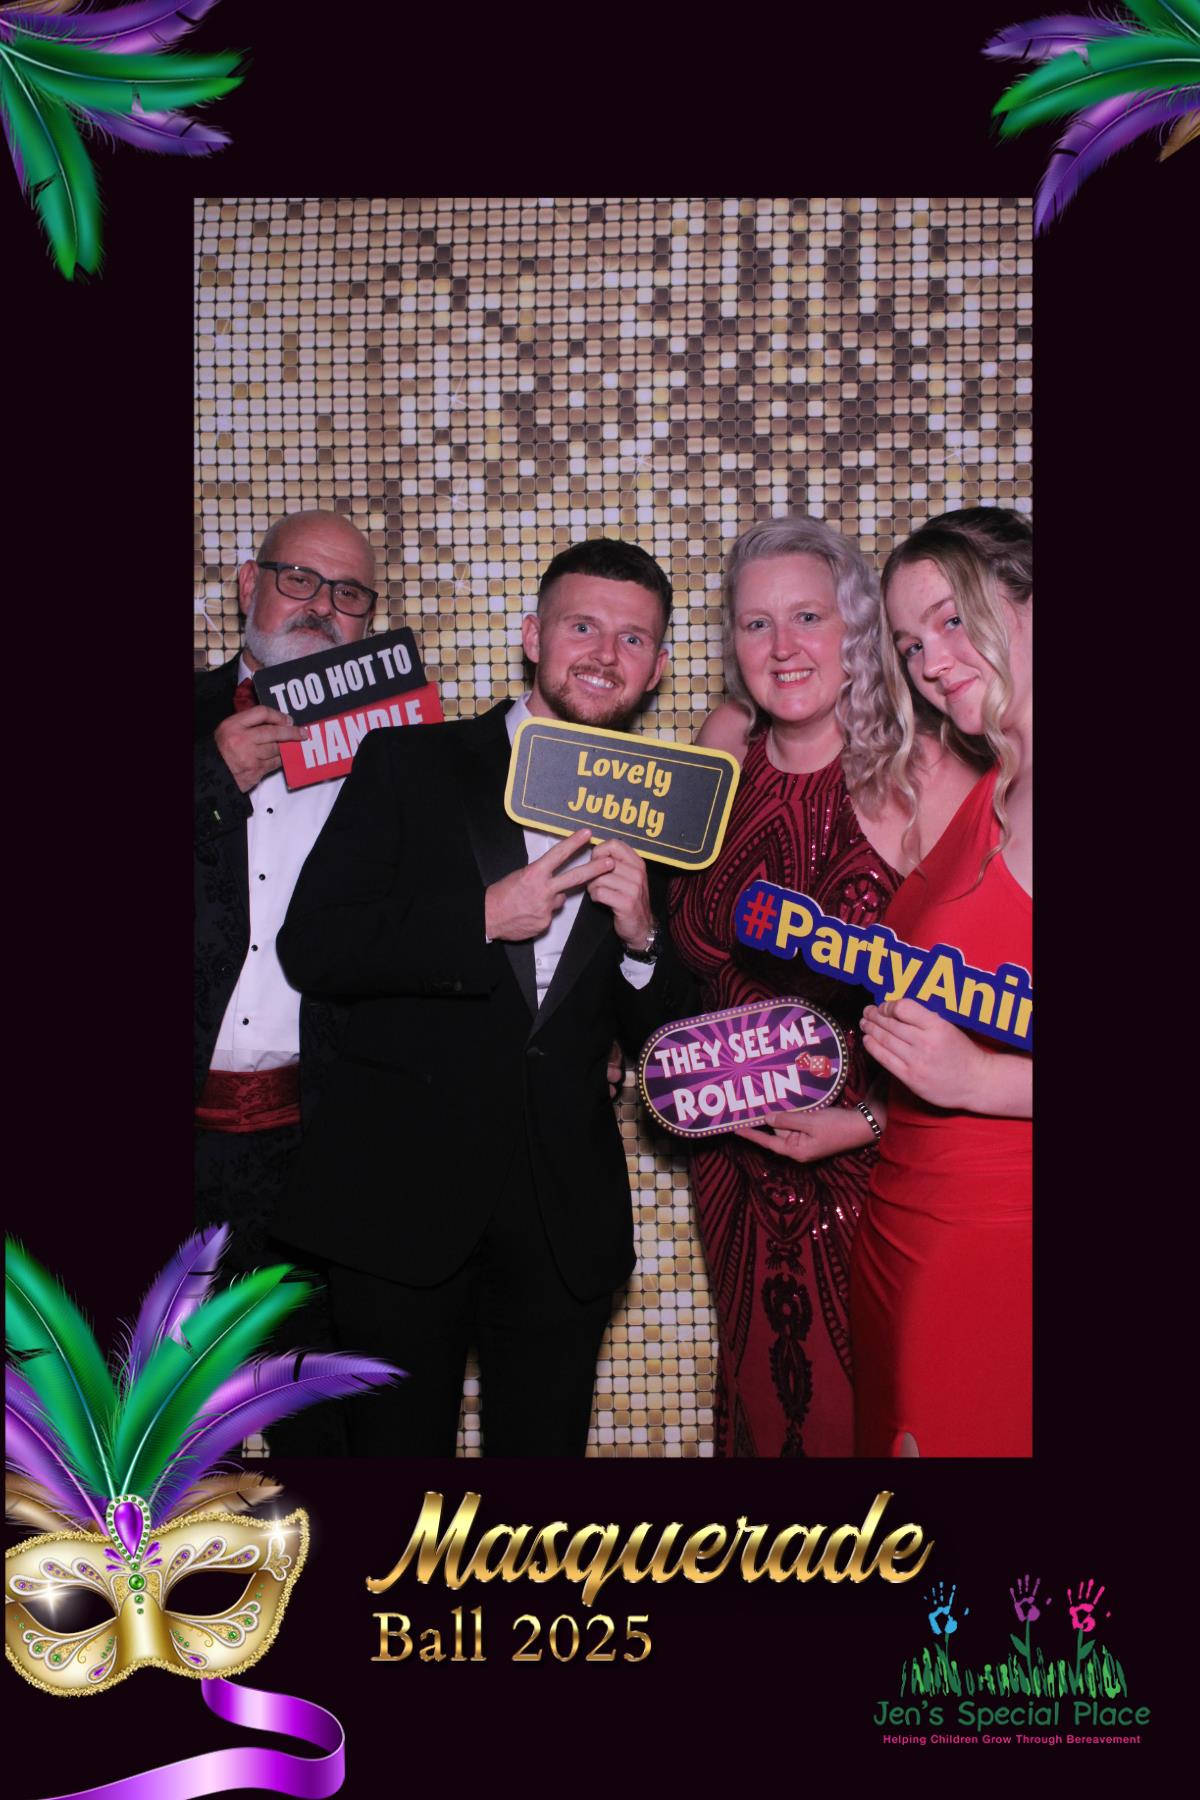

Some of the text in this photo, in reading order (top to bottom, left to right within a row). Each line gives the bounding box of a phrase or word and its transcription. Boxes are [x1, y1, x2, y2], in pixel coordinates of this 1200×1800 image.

[269, 643, 412, 715] TOO HOT TO
[577, 751, 672, 797] Lovely
[568, 787, 665, 838] Jubbly
[655, 1015, 820, 1078] THEY SEE ME
[673, 1063, 802, 1122] ROLLIN
